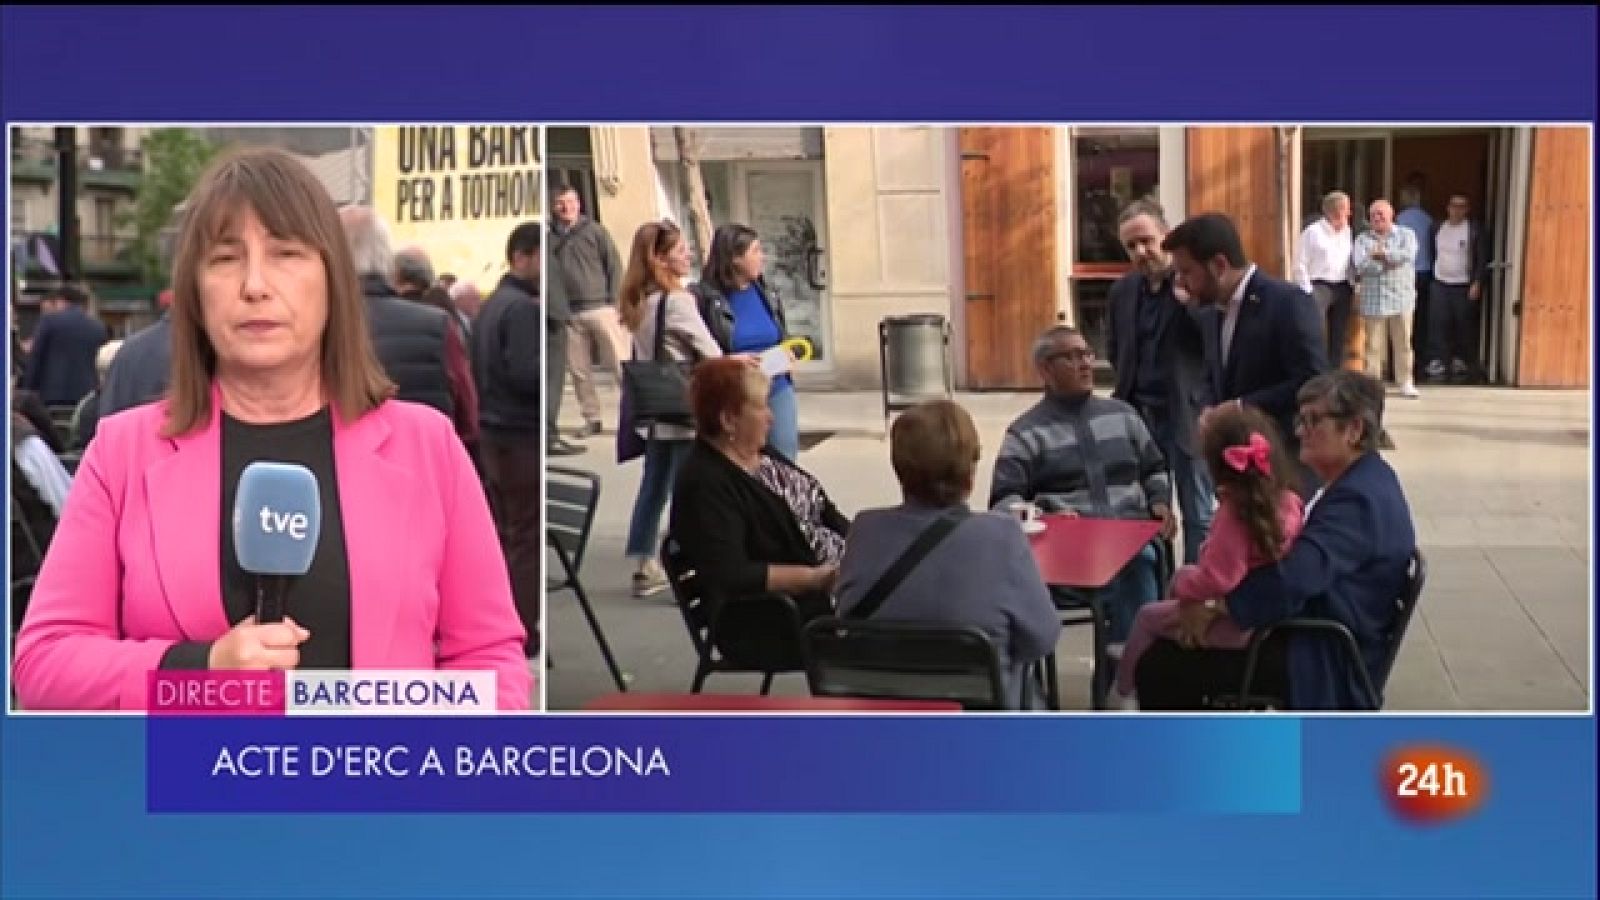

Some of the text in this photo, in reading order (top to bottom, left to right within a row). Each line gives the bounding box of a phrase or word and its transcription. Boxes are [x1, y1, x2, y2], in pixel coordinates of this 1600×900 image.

[399, 126, 456, 173] UNA
[397, 170, 541, 222] PER A TOTHOM
[259, 505, 309, 540] tve
